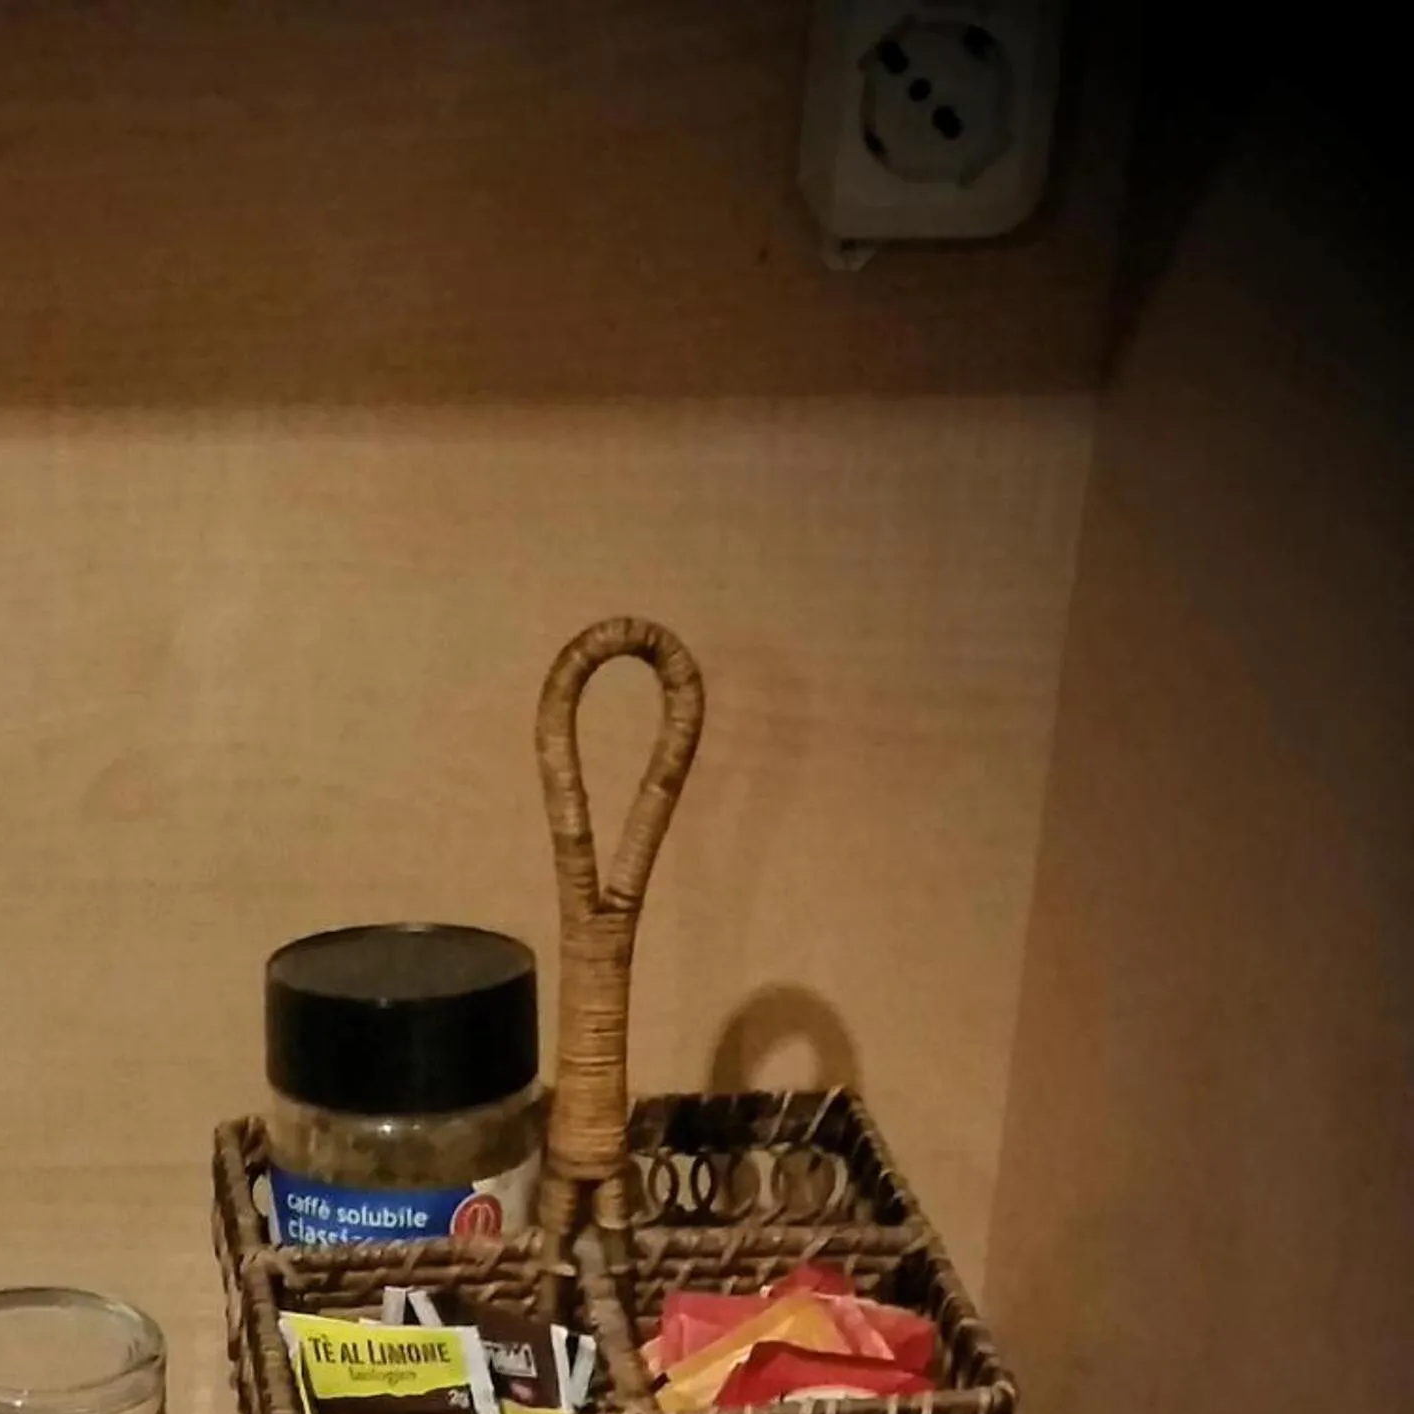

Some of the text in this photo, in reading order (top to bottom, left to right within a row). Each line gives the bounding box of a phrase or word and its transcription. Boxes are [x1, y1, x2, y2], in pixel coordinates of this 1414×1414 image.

[287, 1193, 429, 1229] caffè solubile
[288, 1219, 374, 1246] classi
[340, 1341, 366, 1364] AL
